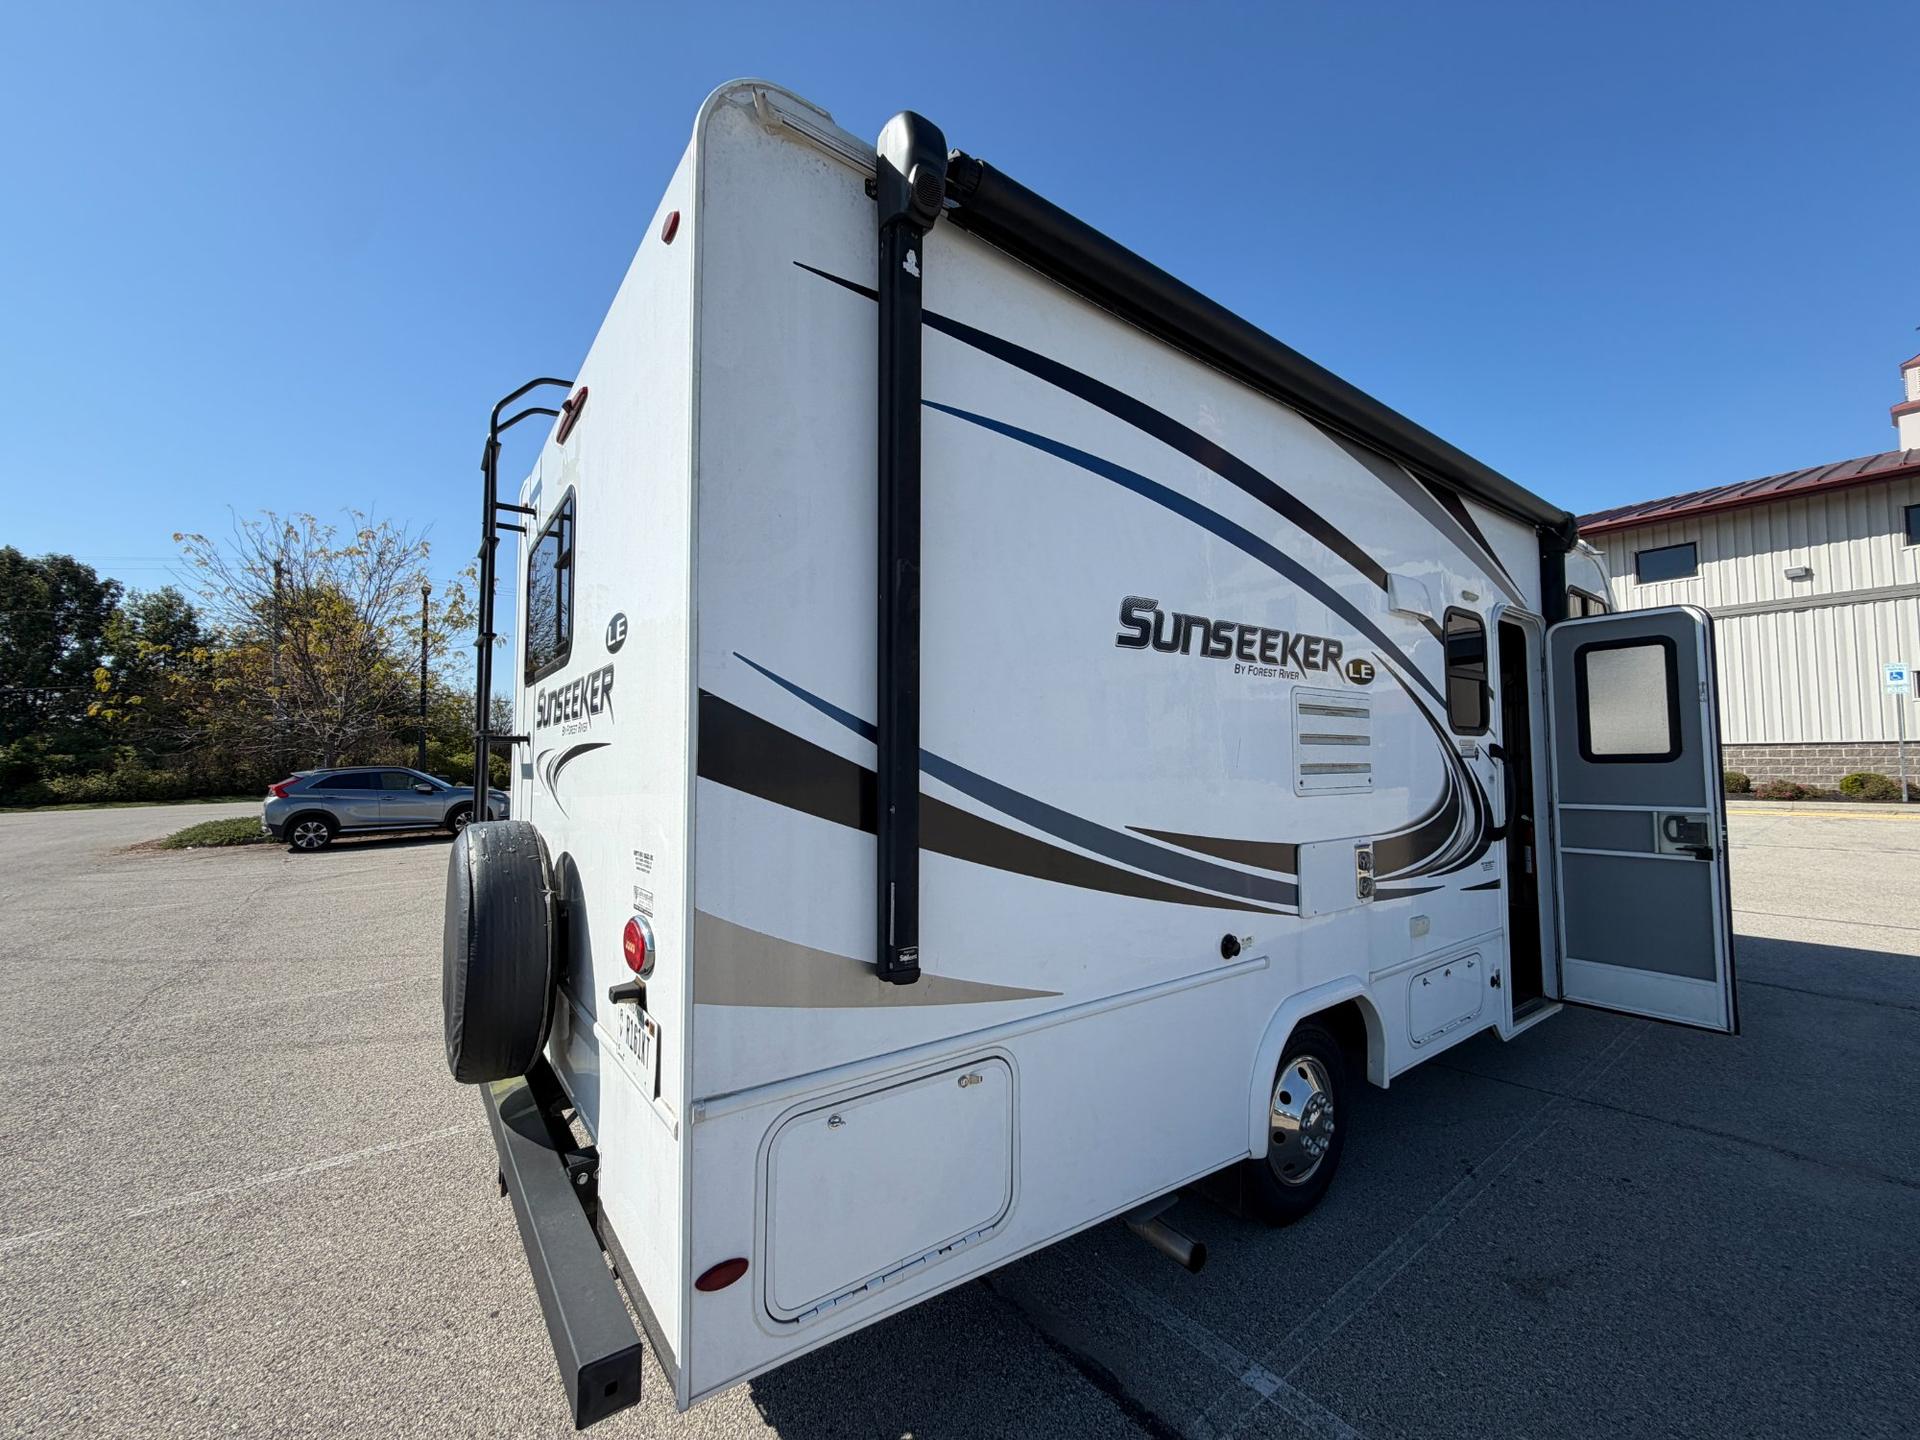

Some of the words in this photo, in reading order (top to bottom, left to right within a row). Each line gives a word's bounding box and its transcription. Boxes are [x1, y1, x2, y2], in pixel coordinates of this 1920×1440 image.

[607, 616, 626, 647] LE
[1115, 595, 1346, 683] SUNSEEKER
[1349, 663, 1372, 679] LE
[1248, 665, 1277, 678] FOREST
[1278, 668, 1299, 681] RIVER
